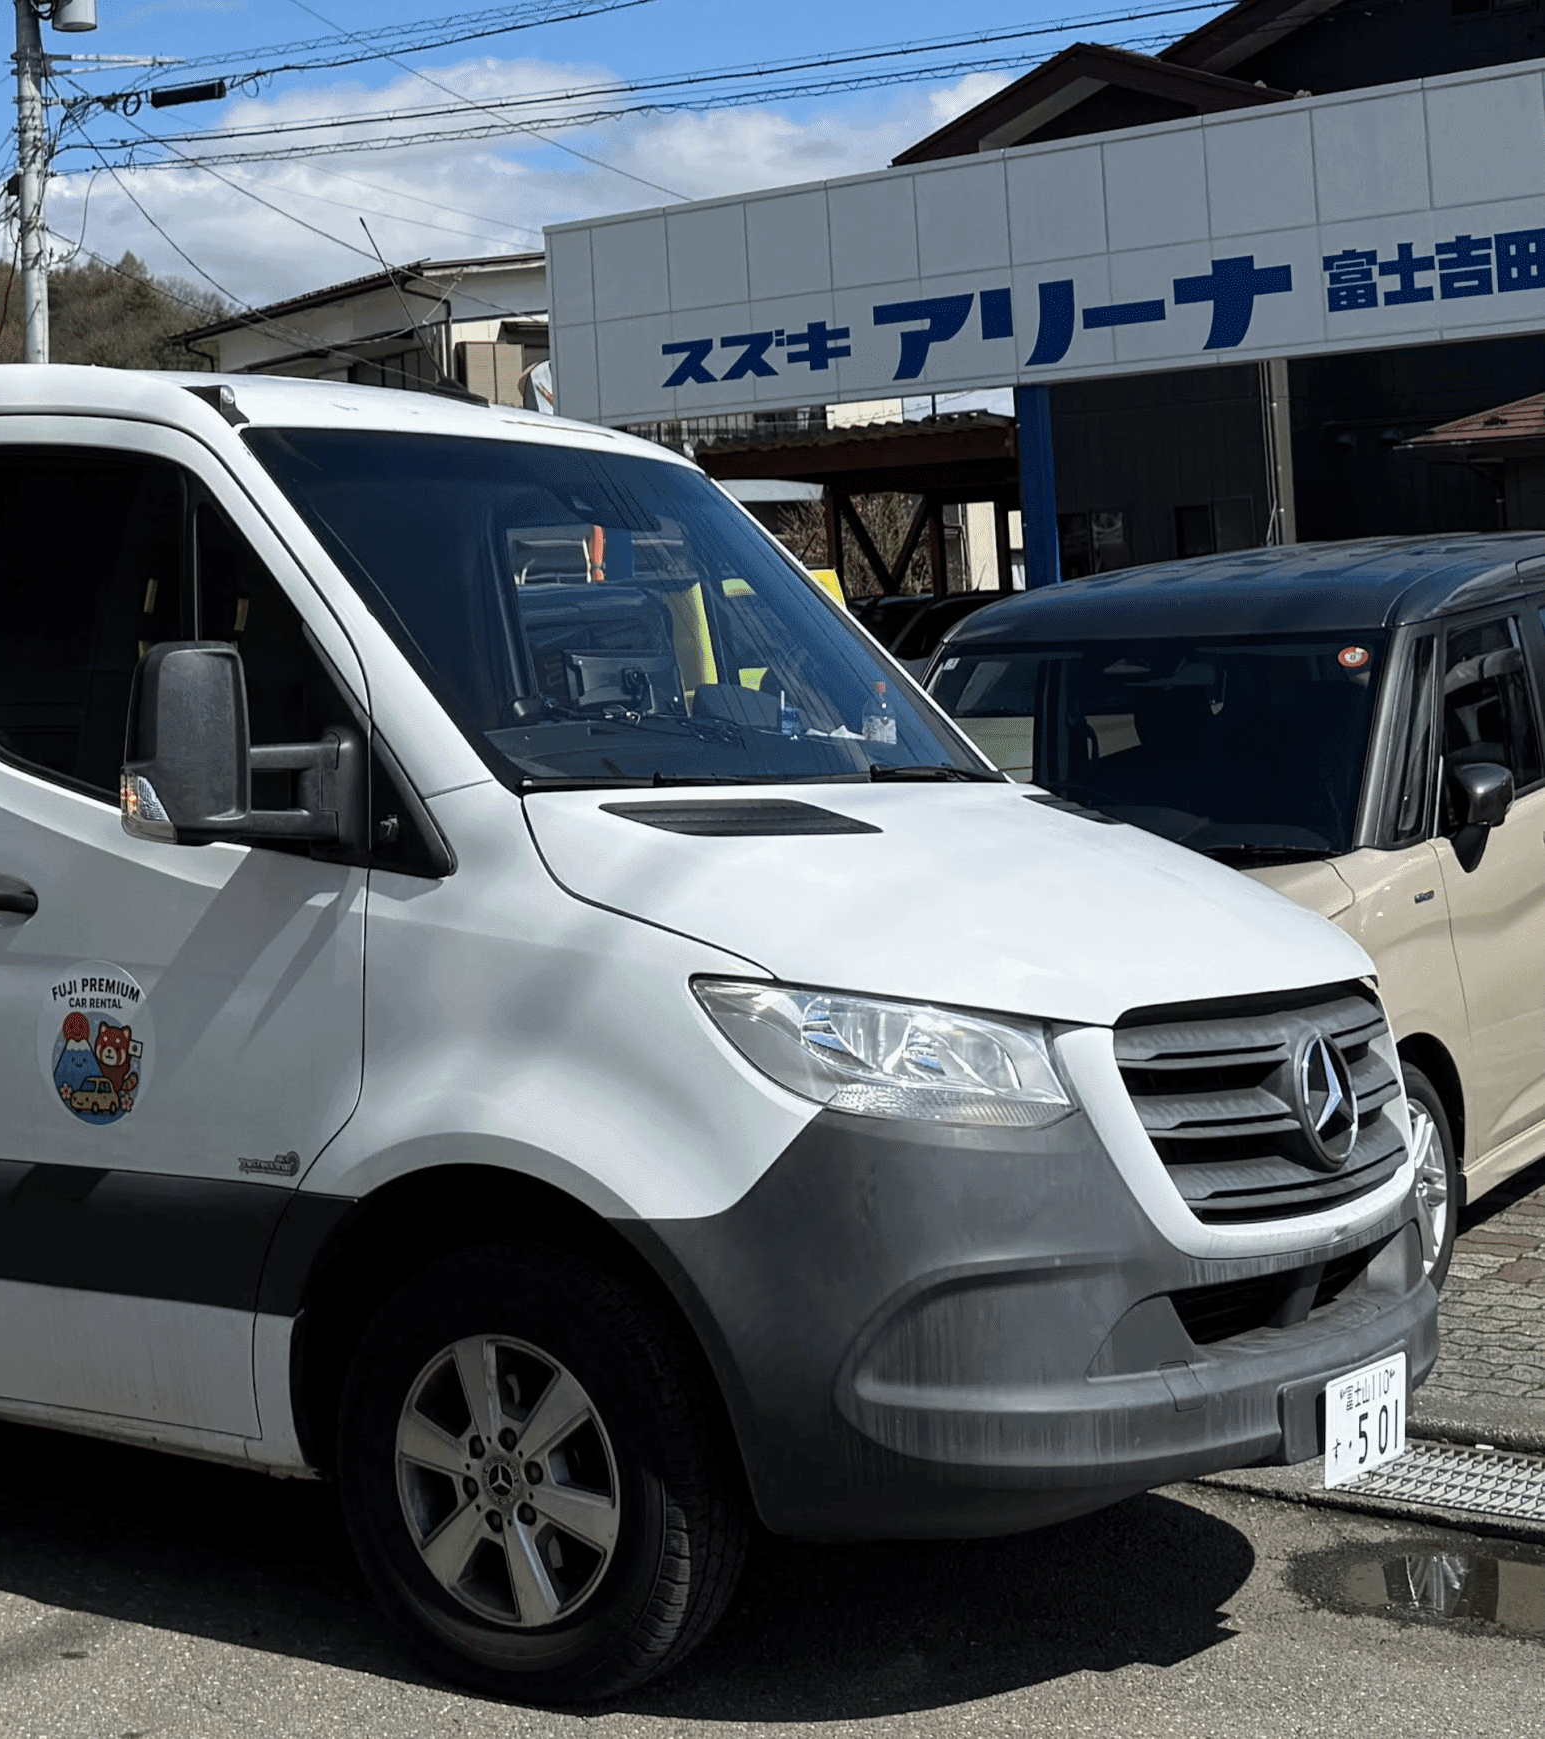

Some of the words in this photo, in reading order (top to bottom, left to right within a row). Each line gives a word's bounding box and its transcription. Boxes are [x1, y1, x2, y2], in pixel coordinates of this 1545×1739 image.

[661, 320, 851, 388] スズキ
[873, 255, 1293, 381] アリーナ
[1322, 227, 1545, 313] 富士吉田
[52, 980, 77, 1001] FUJI
[82, 978, 140, 1002] PREMIUM
[69, 998, 87, 1008] CAR
[89, 998, 123, 1009] RENTAL
